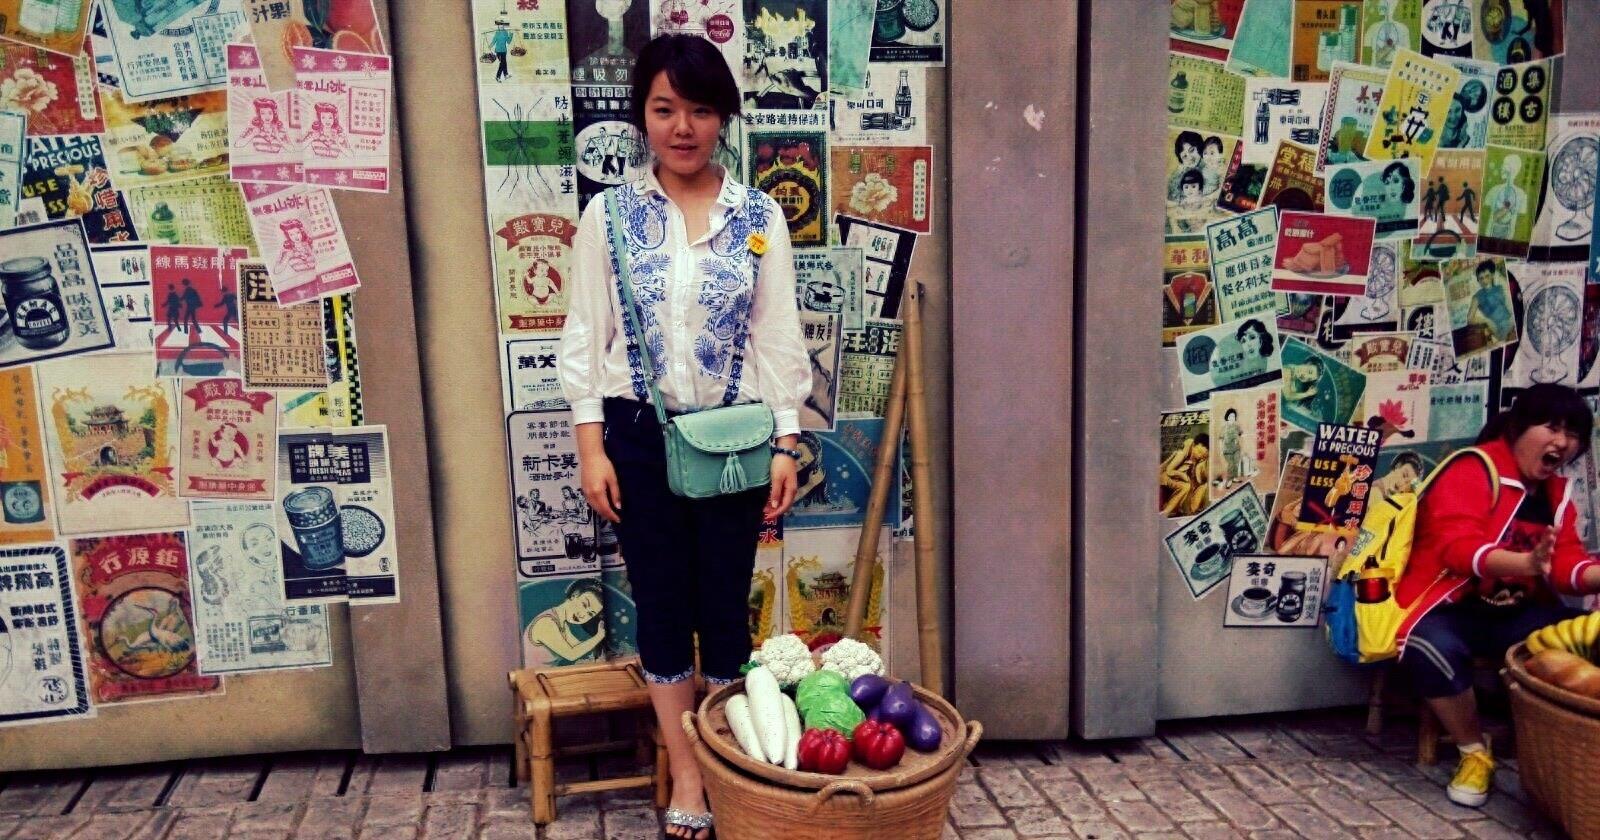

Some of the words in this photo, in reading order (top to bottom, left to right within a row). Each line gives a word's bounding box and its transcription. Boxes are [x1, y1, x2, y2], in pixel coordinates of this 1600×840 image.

[31, 143, 101, 171] PRECIOUS
[23, 179, 58, 198] USE
[48, 199, 66, 213] SS
[1319, 424, 1379, 446] WATER
[1318, 440, 1329, 452] IS
[1329, 441, 1377, 458] PRECIOUS
[1314, 458, 1338, 471] USE
[1310, 475, 1336, 488] LESS
